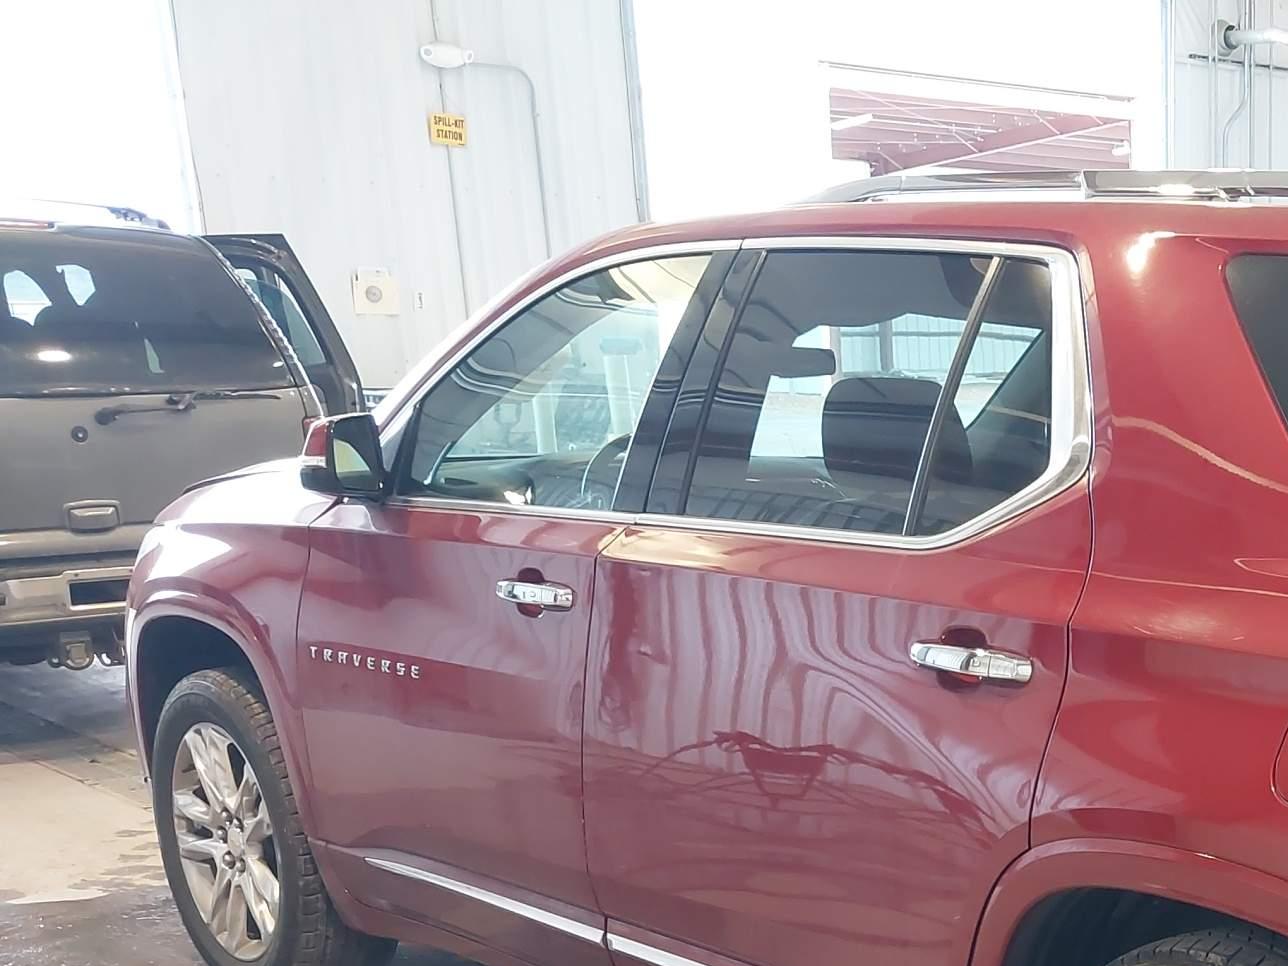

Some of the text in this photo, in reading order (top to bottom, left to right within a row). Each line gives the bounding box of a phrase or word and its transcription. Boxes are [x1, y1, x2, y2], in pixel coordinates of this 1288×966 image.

[433, 115, 465, 129] SPILL-KIT
[436, 128, 463, 142] STATION
[309, 645, 420, 679] TRAVERSE
